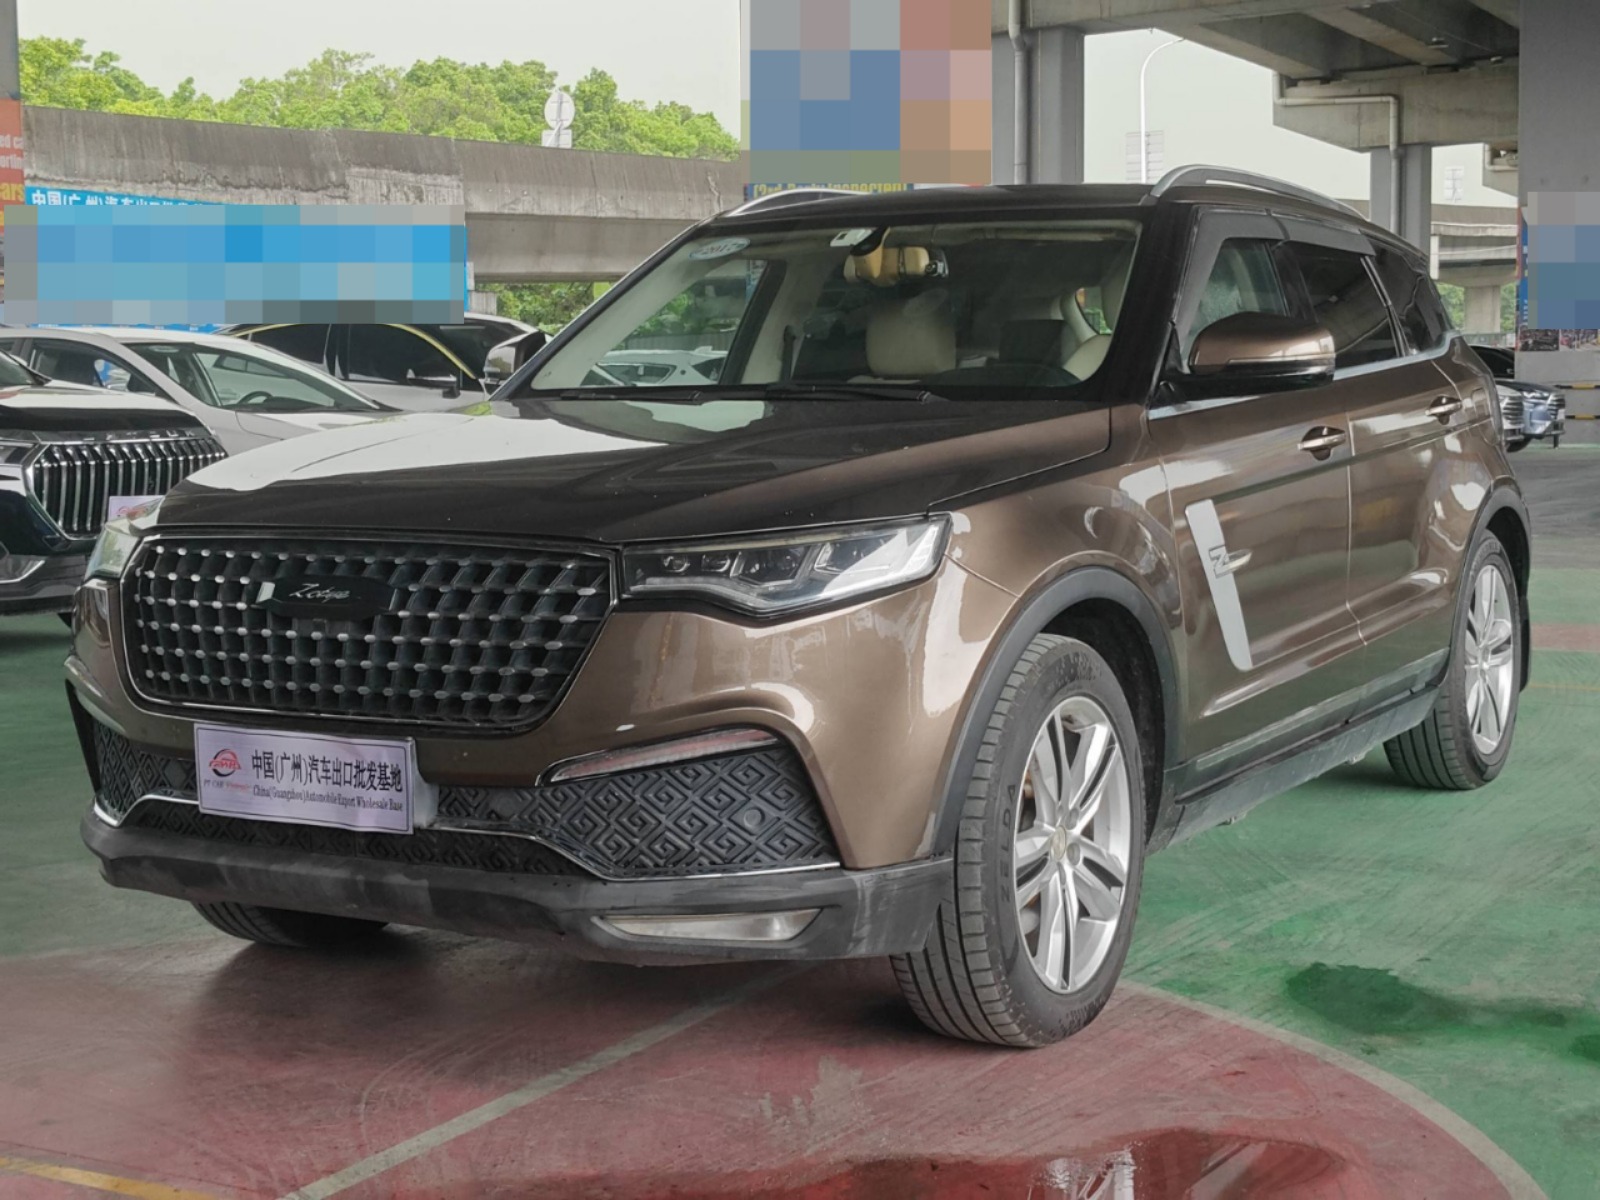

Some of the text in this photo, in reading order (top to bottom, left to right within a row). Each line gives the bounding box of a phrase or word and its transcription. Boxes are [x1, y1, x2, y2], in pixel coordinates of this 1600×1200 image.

[251, 749, 404, 793] 中国(广州)汽车出口批发基地
